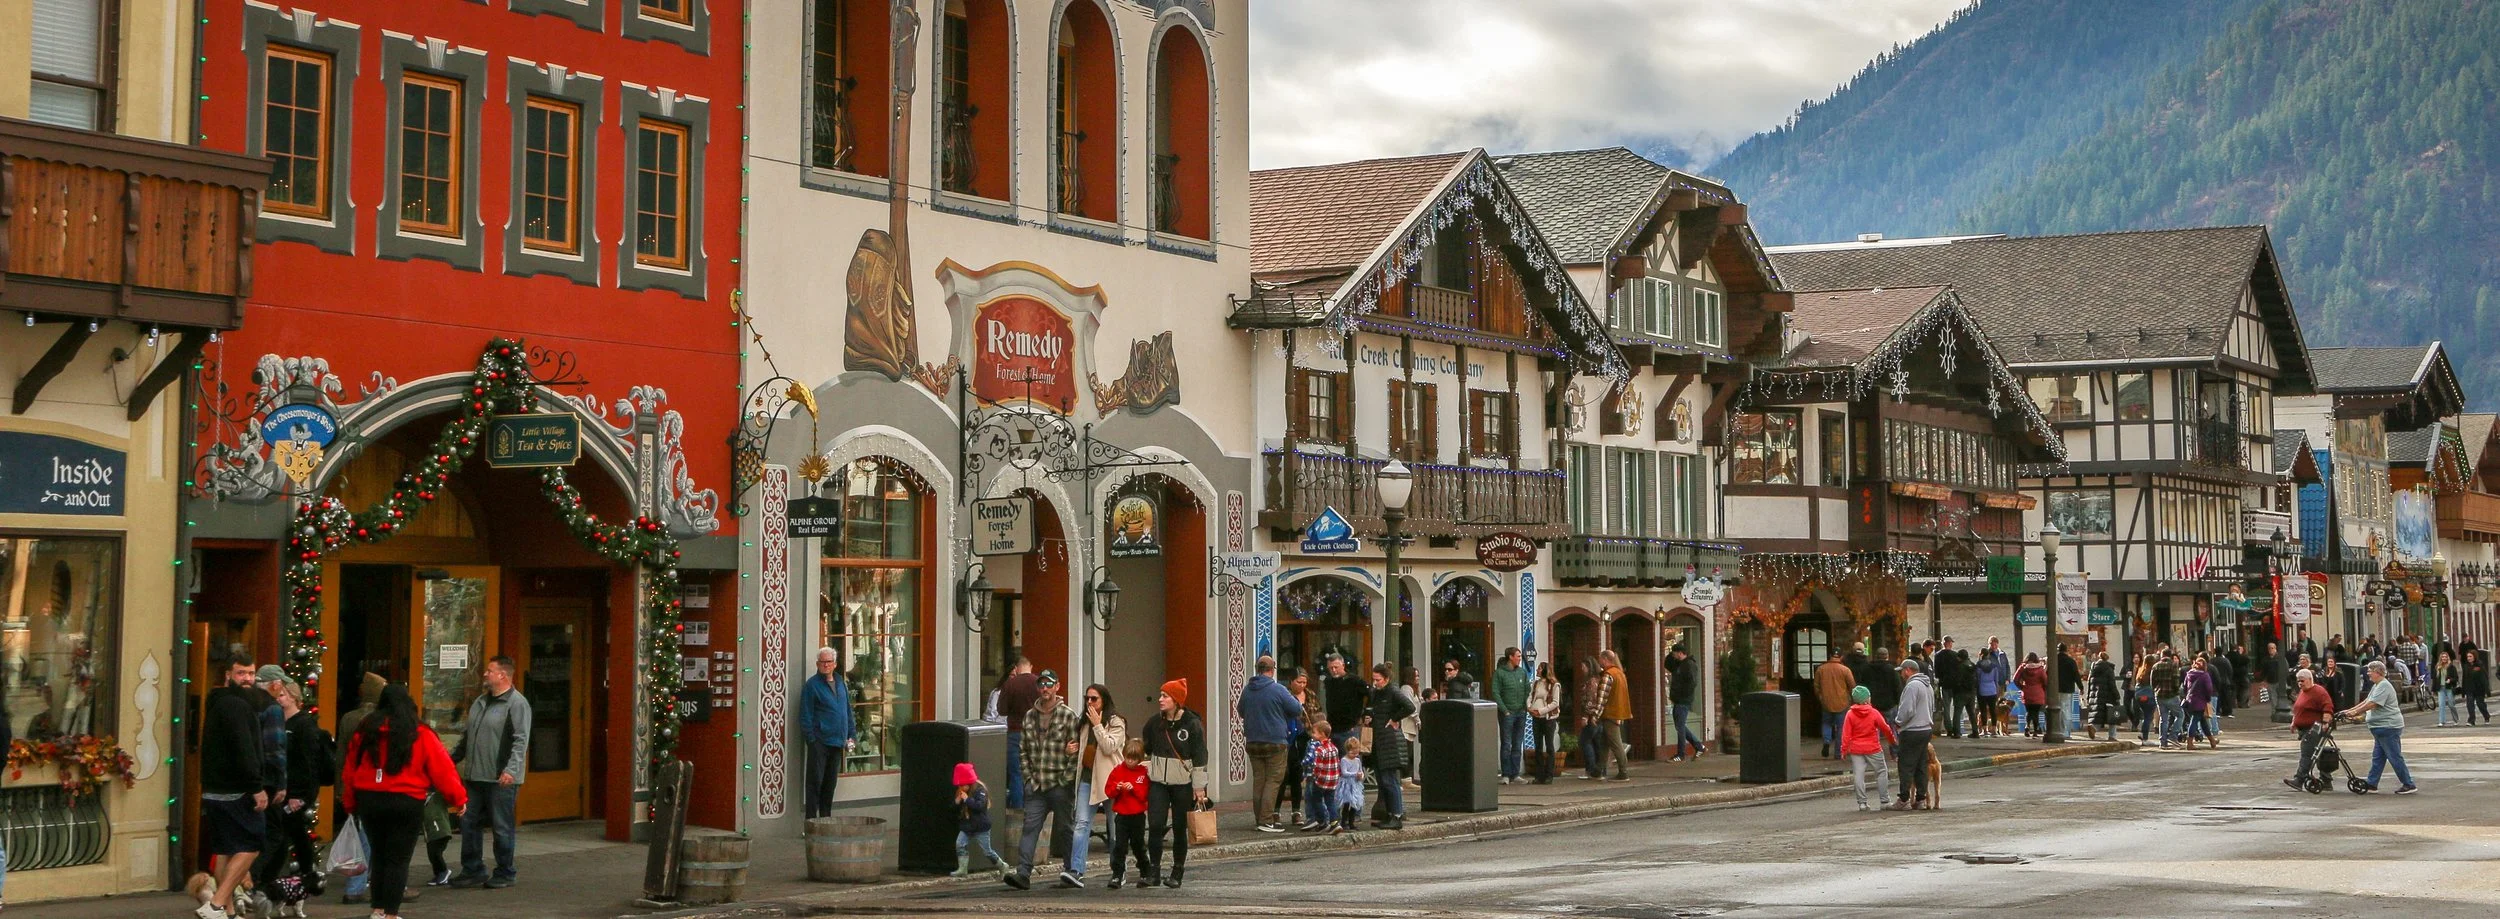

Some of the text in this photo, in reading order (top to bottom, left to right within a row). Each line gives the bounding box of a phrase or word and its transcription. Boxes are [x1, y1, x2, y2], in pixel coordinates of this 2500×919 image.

[987, 318, 1063, 369] Remedy
[1361, 344, 1388, 367] Creek
[996, 362, 1020, 381] Forest
[1031, 367, 1056, 385] Home
[264, 419, 278, 432] The
[320, 415, 335, 434] Shop
[521, 426, 567, 438] Little Village
[517, 439, 573, 454] Tea & Spice
[52, 456, 113, 485] Inside
[64, 490, 111, 507] and Out
[978, 500, 1023, 521] Remedy
[790, 517, 837, 526] ALPINE GROUP
[988, 520, 1014, 532] Forest
[989, 540, 1015, 551] Home
[1480, 534, 1532, 555] Studio 1890
[1226, 556, 1274, 571] Alpen Dorf
[2057, 582, 2070, 592] More
[2061, 593, 2083, 605] Shopping
[2092, 612, 2110, 621] Store
